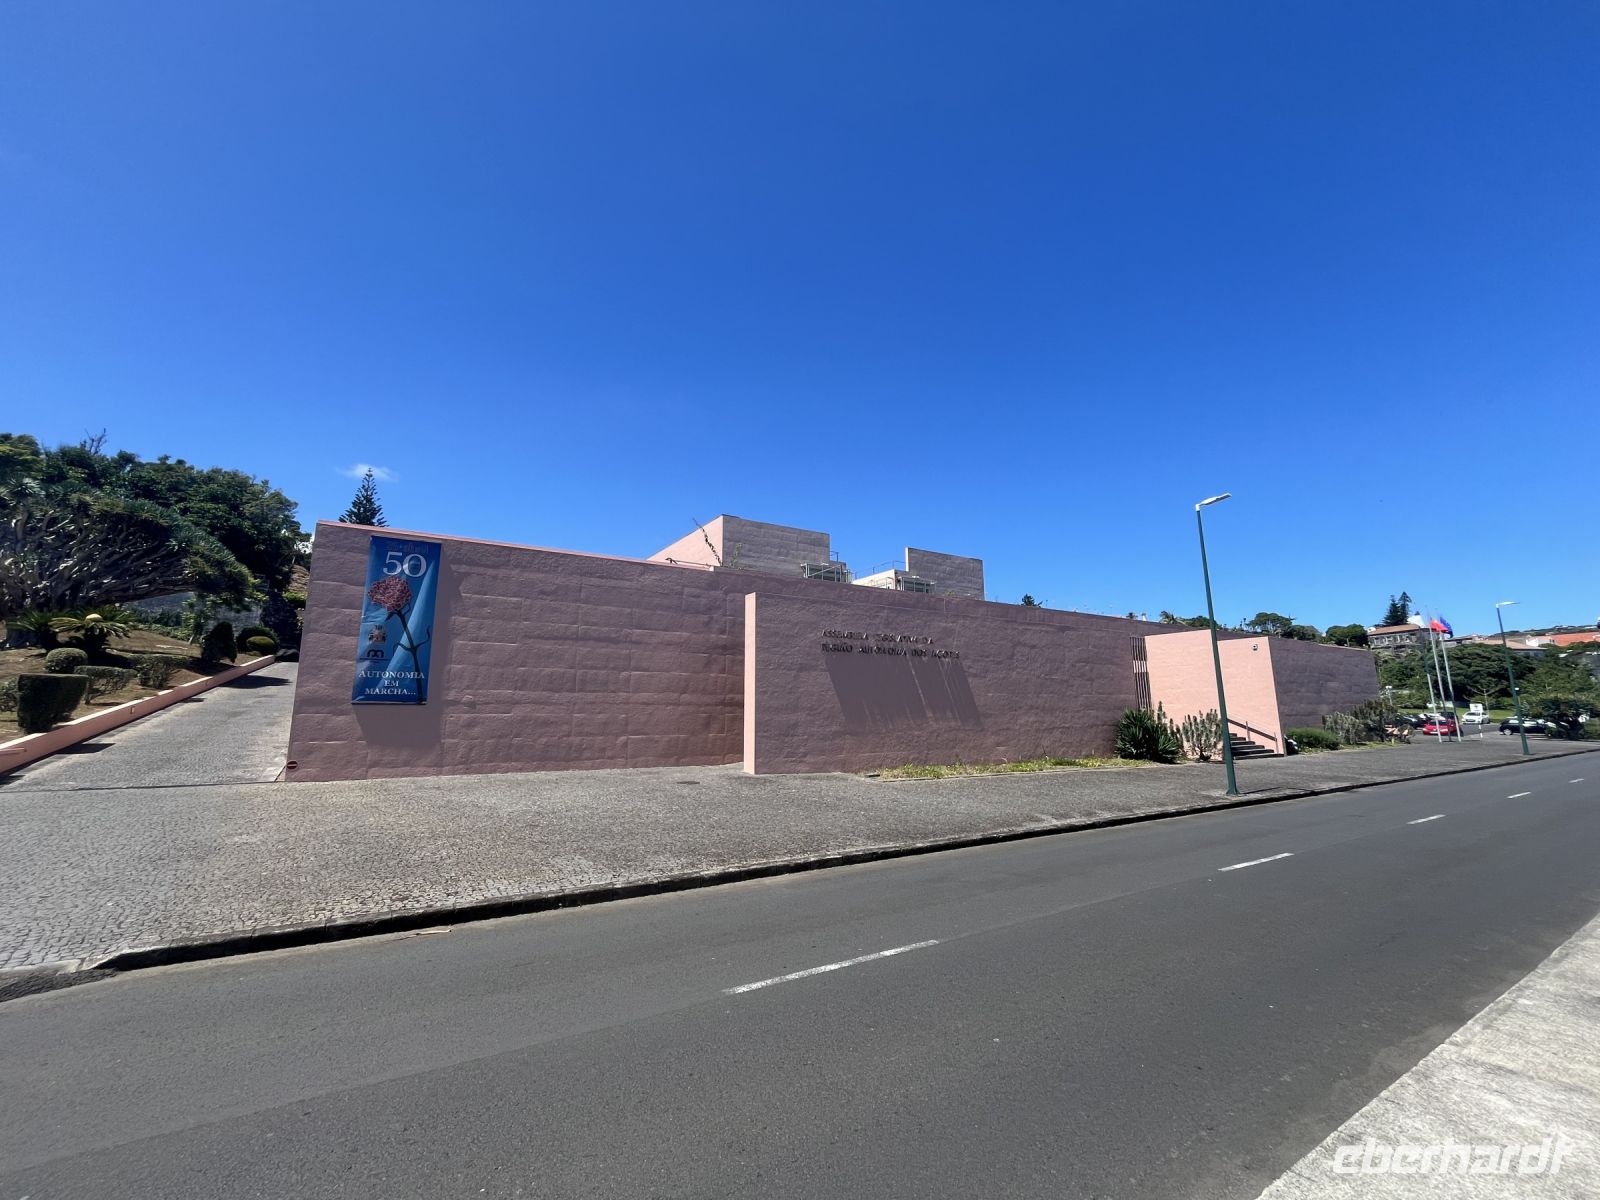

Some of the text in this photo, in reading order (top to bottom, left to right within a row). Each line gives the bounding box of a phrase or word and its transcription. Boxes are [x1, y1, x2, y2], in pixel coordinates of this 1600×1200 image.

[383, 551, 427, 577] 50
[358, 670, 425, 679] AUTONOMIA
[364, 687, 416, 695] MARCHA...
